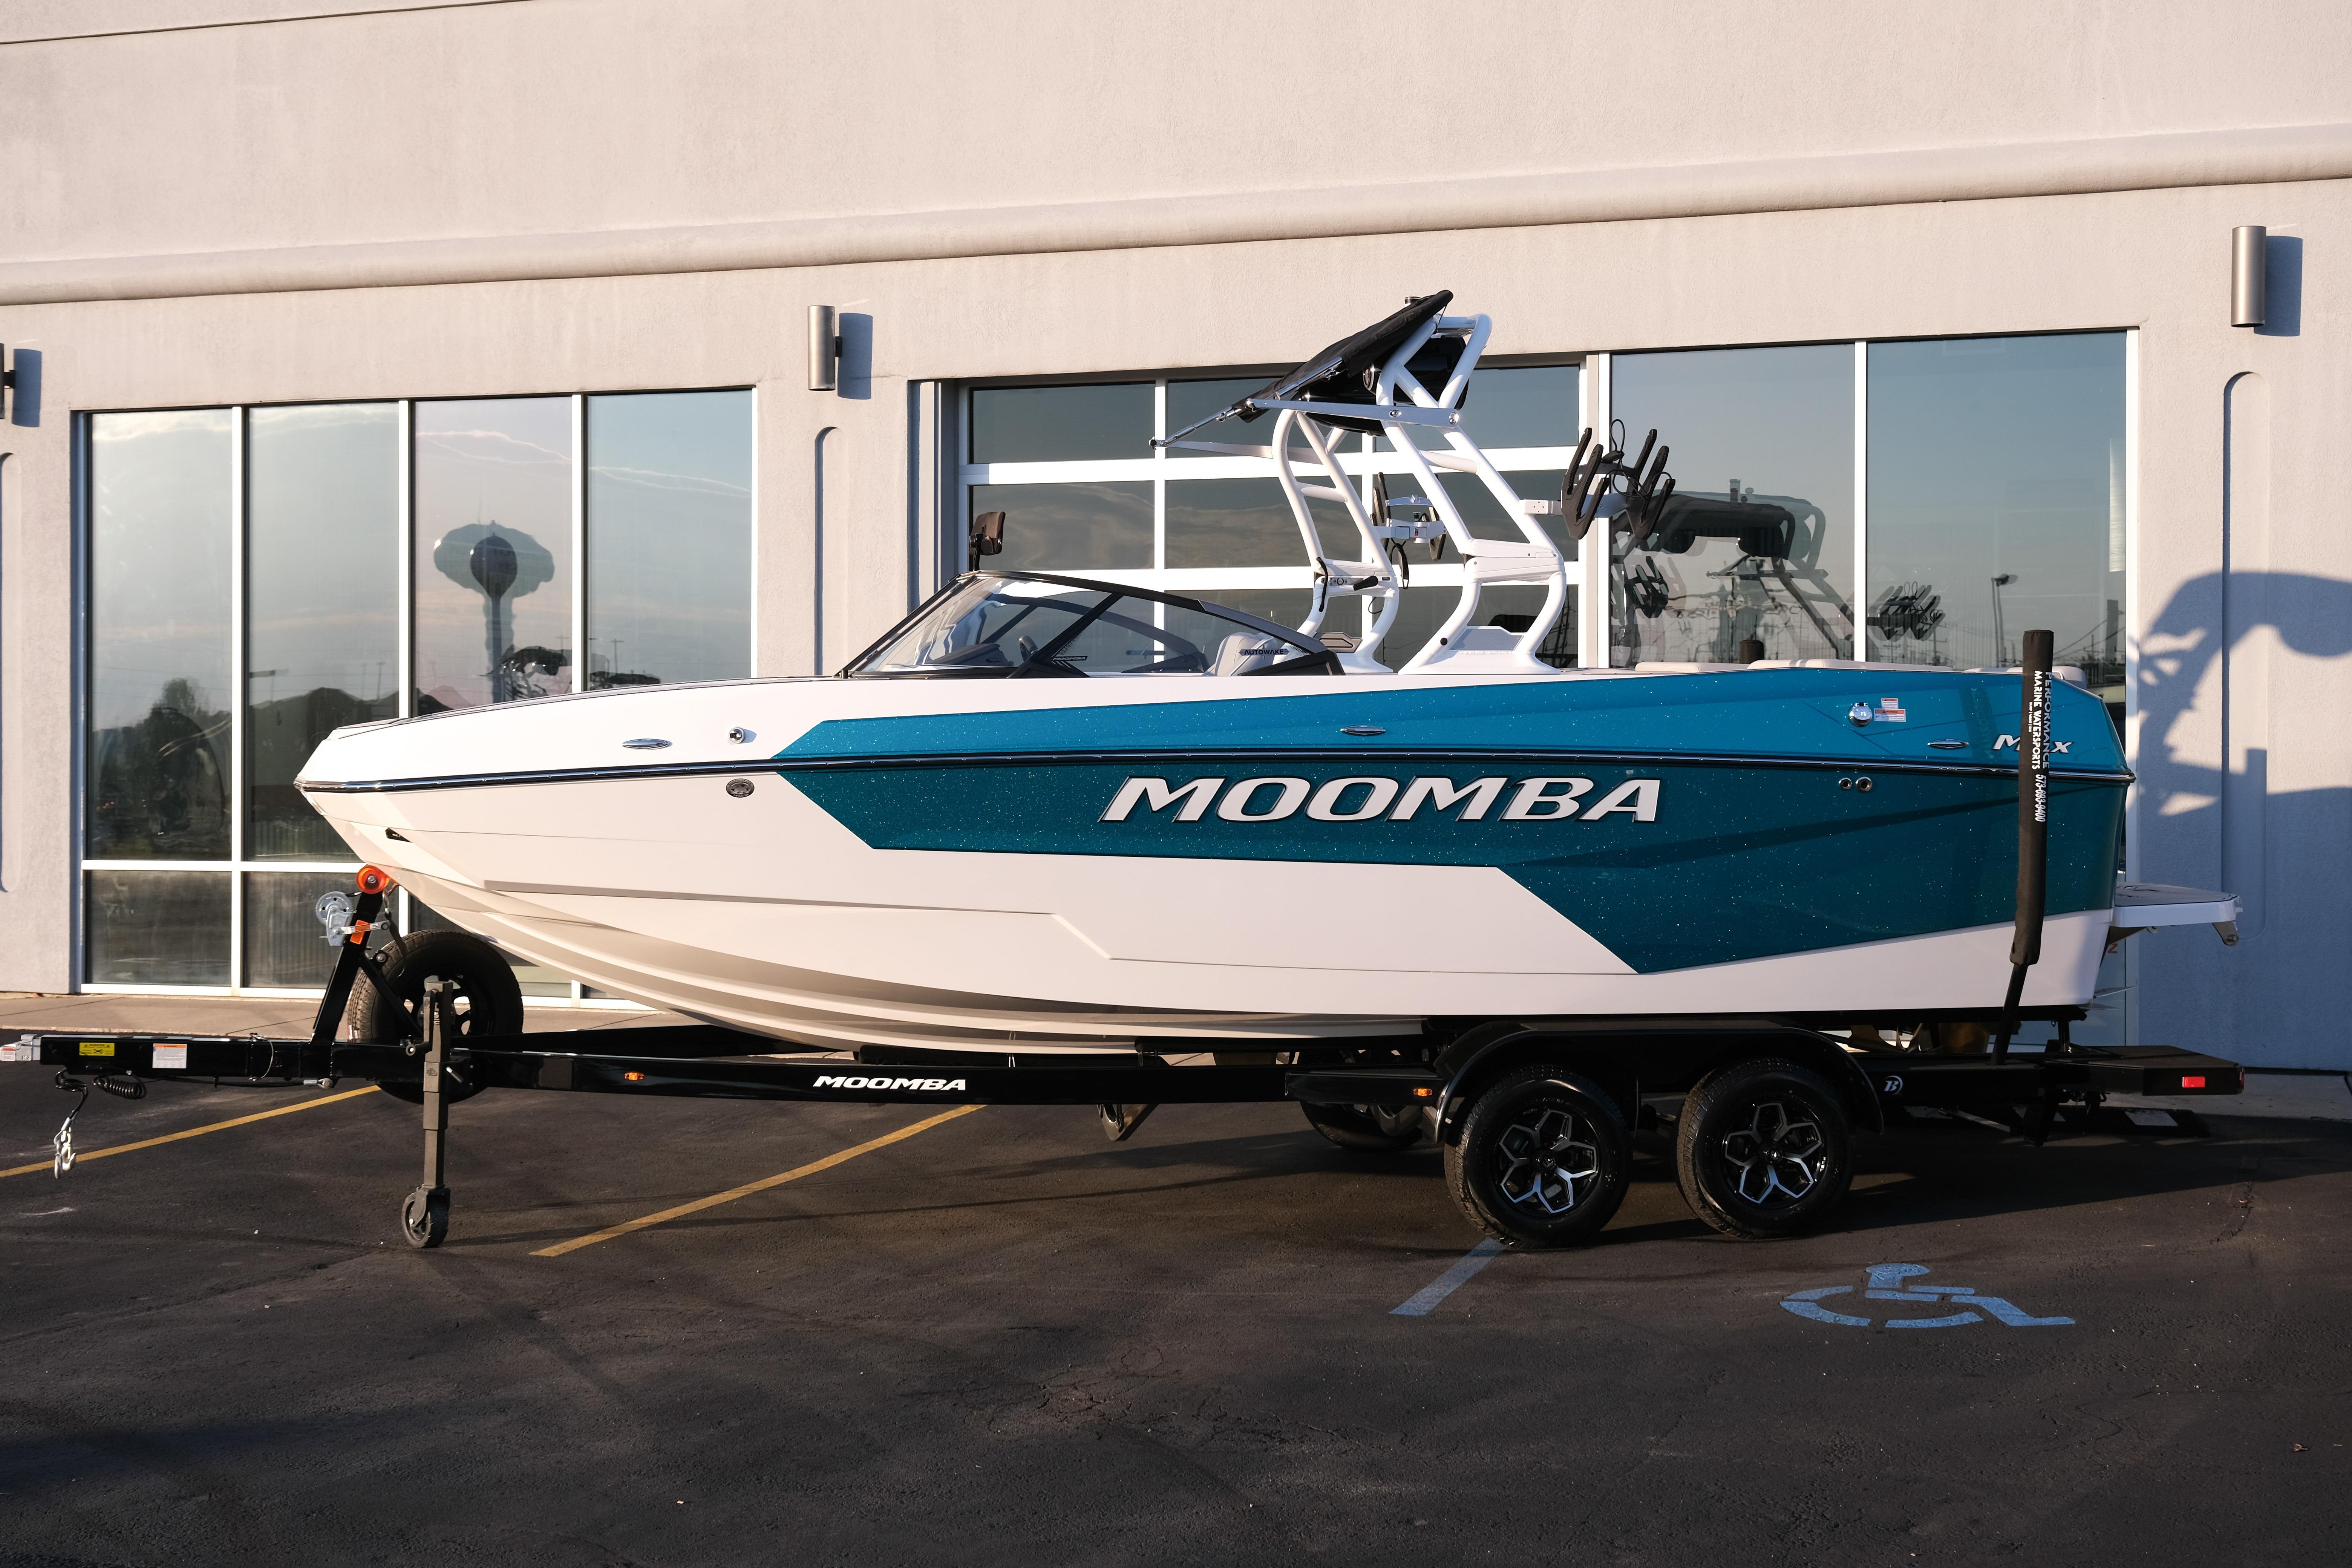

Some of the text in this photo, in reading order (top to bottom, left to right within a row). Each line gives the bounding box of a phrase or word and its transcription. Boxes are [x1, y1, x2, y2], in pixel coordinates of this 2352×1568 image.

[1993, 734, 2073, 753] MX
[2032, 671, 2043, 770] MARINE WATERSPORTS
[2043, 671, 2052, 769] PERFORMANCE
[1098, 775, 1661, 823] MOOMBA
[2035, 774, 2047, 822] 573-693-9400
[813, 1076, 966, 1091] MOOMBA
